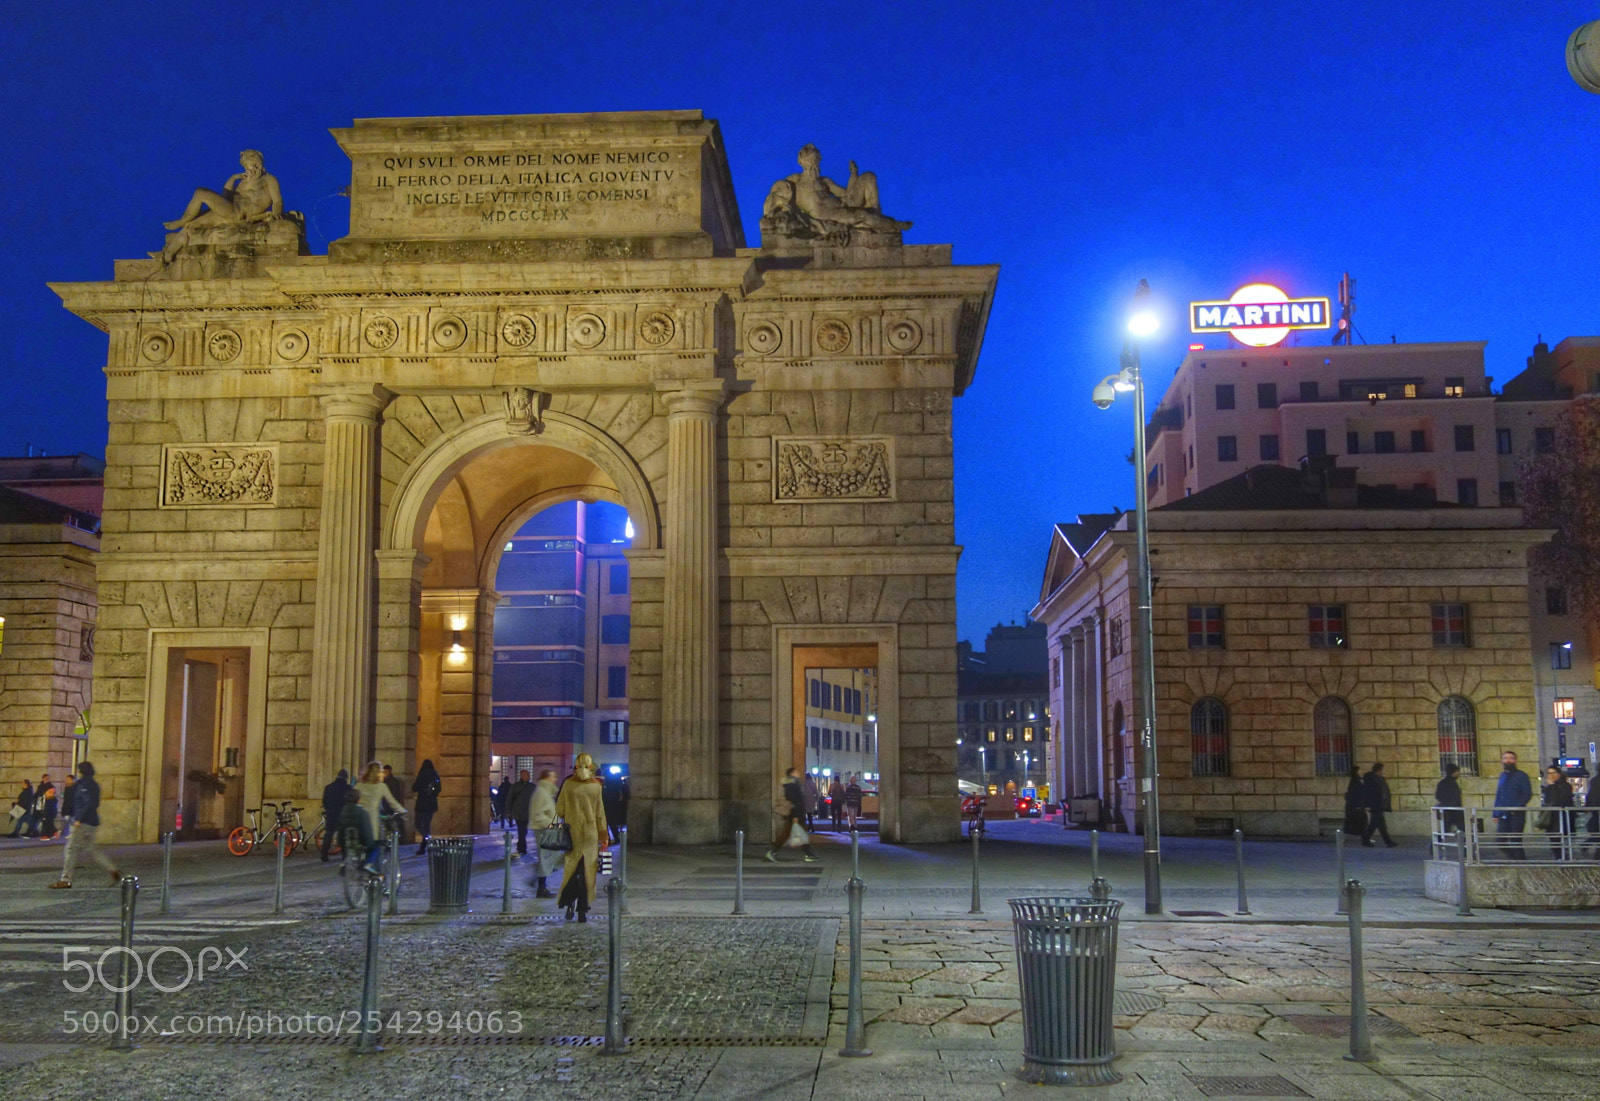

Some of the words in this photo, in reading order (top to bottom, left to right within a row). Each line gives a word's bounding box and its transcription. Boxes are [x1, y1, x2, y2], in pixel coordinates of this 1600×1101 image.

[384, 158, 412, 170] QVI
[418, 156, 457, 169] SVLL
[464, 155, 511, 167] ORME
[516, 154, 546, 166] DEL
[552, 153, 600, 165] NOME
[606, 151, 670, 164] NEMICO
[377, 176, 391, 187] IL
[398, 175, 451, 187] FERRO
[457, 174, 510, 186] DELLA
[518, 172, 583, 184] ITALICA
[589, 170, 674, 183] GIOVENTV
[407, 193, 458, 205] INCISE
[465, 192, 484, 204] LE
[491, 190, 571, 203] VITTORIE
[577, 189, 648, 201] COMENSI
[481, 209, 569, 221] MDCCCLIX
[1199, 304, 1320, 326] MARTINI
